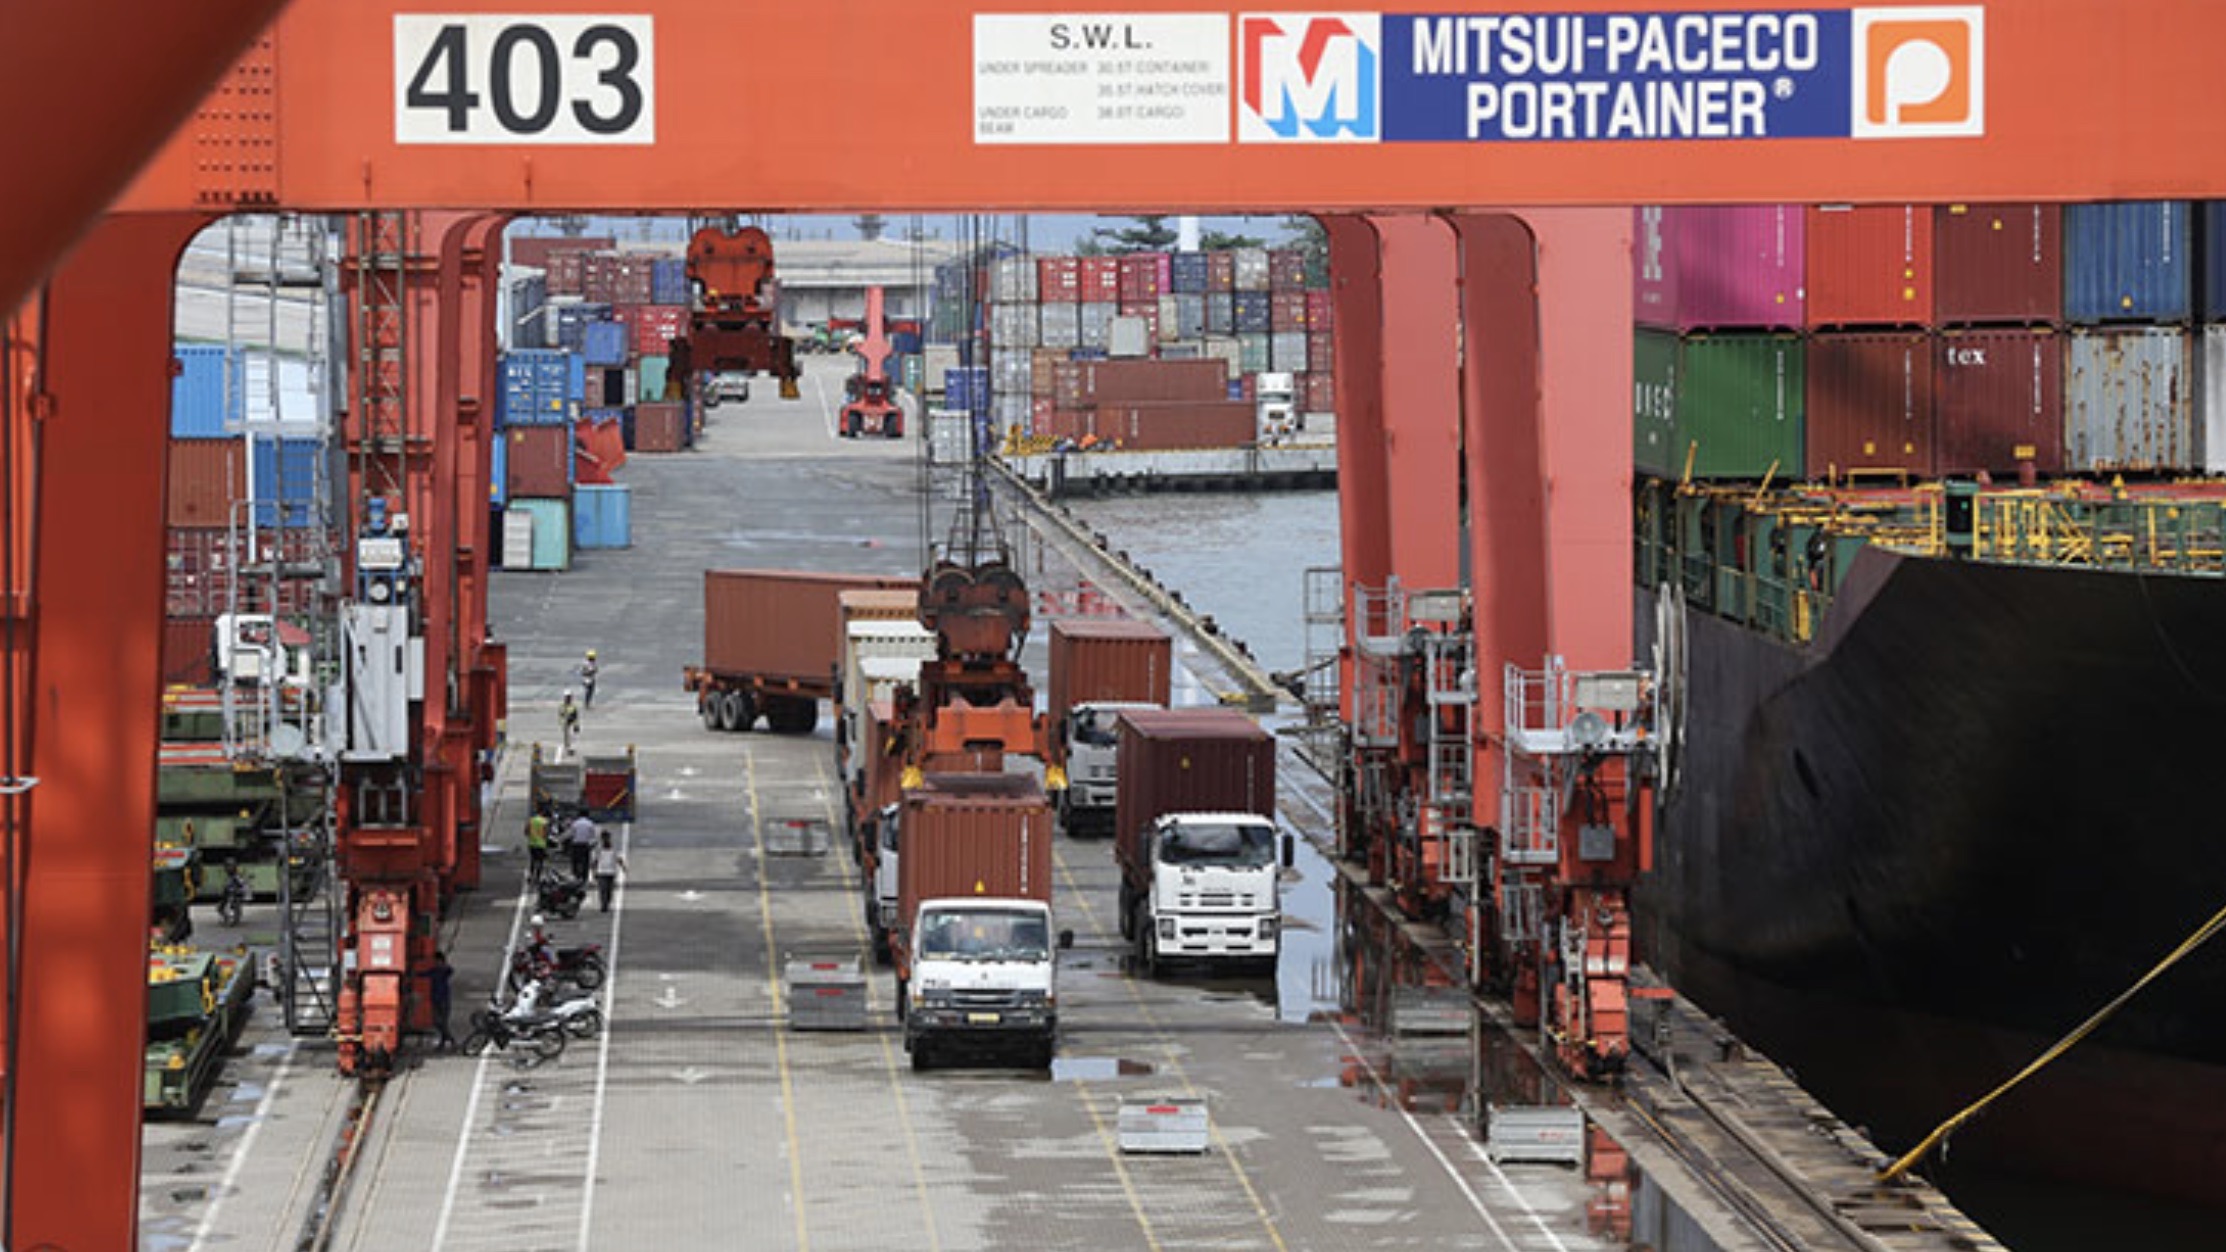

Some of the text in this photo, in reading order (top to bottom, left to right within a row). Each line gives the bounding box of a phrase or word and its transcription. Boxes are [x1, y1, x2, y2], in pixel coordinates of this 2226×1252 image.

[1050, 22, 1153, 50] S.W.L.
[1412, 14, 1818, 76] MITSUI-PACECO
[978, 61, 1088, 75] UNDER SPREADER
[405, 23, 644, 135] 403
[978, 107, 1069, 120] UNDER CARGO
[979, 122, 1014, 135] BEAM
[1946, 346, 1987, 366] tex
